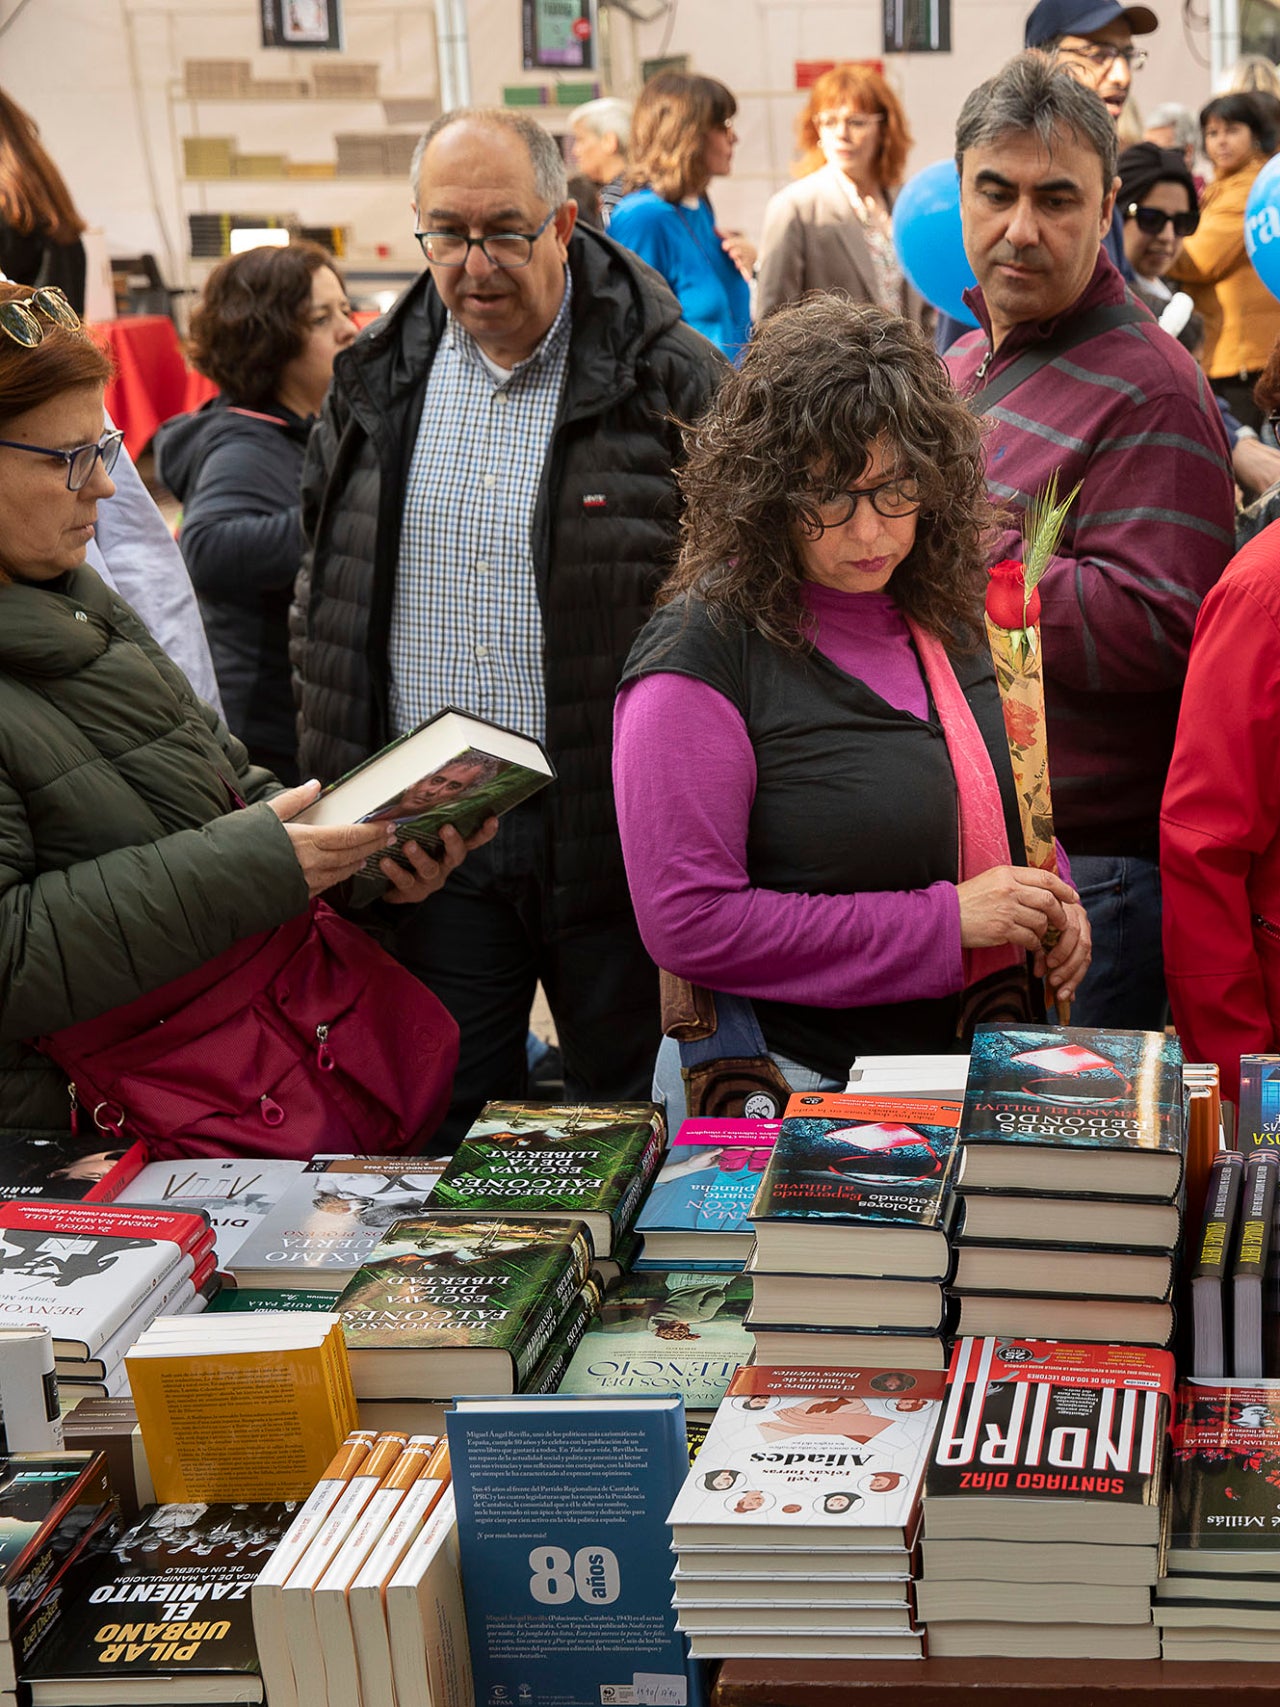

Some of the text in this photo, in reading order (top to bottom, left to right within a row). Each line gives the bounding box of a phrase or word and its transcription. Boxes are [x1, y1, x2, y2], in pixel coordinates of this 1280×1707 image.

[973, 1103, 1068, 1115] EL DILUVI
[995, 1113, 1148, 1130] REDONDO
[1000, 1123, 1142, 1139] DOLORES
[486, 1150, 600, 1159] LLIBERTAT
[488, 1165, 583, 1174] ESCLAVA
[451, 1178, 603, 1188] FALCONES
[690, 1184, 756, 1192] plancha
[458, 1187, 585, 1196] ILDEFONSO
[772, 1189, 862, 1201] Esperando
[774, 1183, 855, 1196] al diluvio
[858, 1200, 922, 1214] Dolores
[869, 1194, 941, 1209] Redondo
[24, 1213, 158, 1229] PREMI RAMON LLULL
[55, 1223, 93, 1232] edició
[281, 1238, 373, 1249] UERTA
[265, 1250, 367, 1264] ÁXIMO
[387, 1275, 511, 1285] LIBERTAD
[409, 1285, 480, 1294] DE LA
[386, 1294, 490, 1304] ESCLAVA
[341, 1309, 510, 1321] FALCONES
[348, 1321, 488, 1330] ILDEFONSO
[587, 1361, 741, 1377] ILENCIO
[827, 1371, 861, 1379] Dones
[596, 1377, 697, 1389] AÑOS DEL
[1027, 1373, 1089, 1382] 100.000 LECTORES
[935, 1336, 1158, 1475] INDIRA
[490, 1429, 507, 1438] Ángel
[562, 1430, 586, 1438] políticos
[749, 1452, 875, 1467] Aliades
[806, 1469, 851, 1477] Feixas
[959, 1472, 1125, 1494] SANTIAGO DÍAZ
[1206, 1516, 1265, 1527] Millás
[165, 1565, 245, 1574] DE UN PUEBLO
[529, 1545, 621, 1604] 80
[113, 1574, 199, 1584] MANIPULACIÓN
[588, 1554, 607, 1599] años
[88, 1581, 253, 1603] ZAMIENTO
[160, 1602, 200, 1621] EL
[93, 1621, 232, 1643] URBANO
[98, 1641, 202, 1663] PILAR
